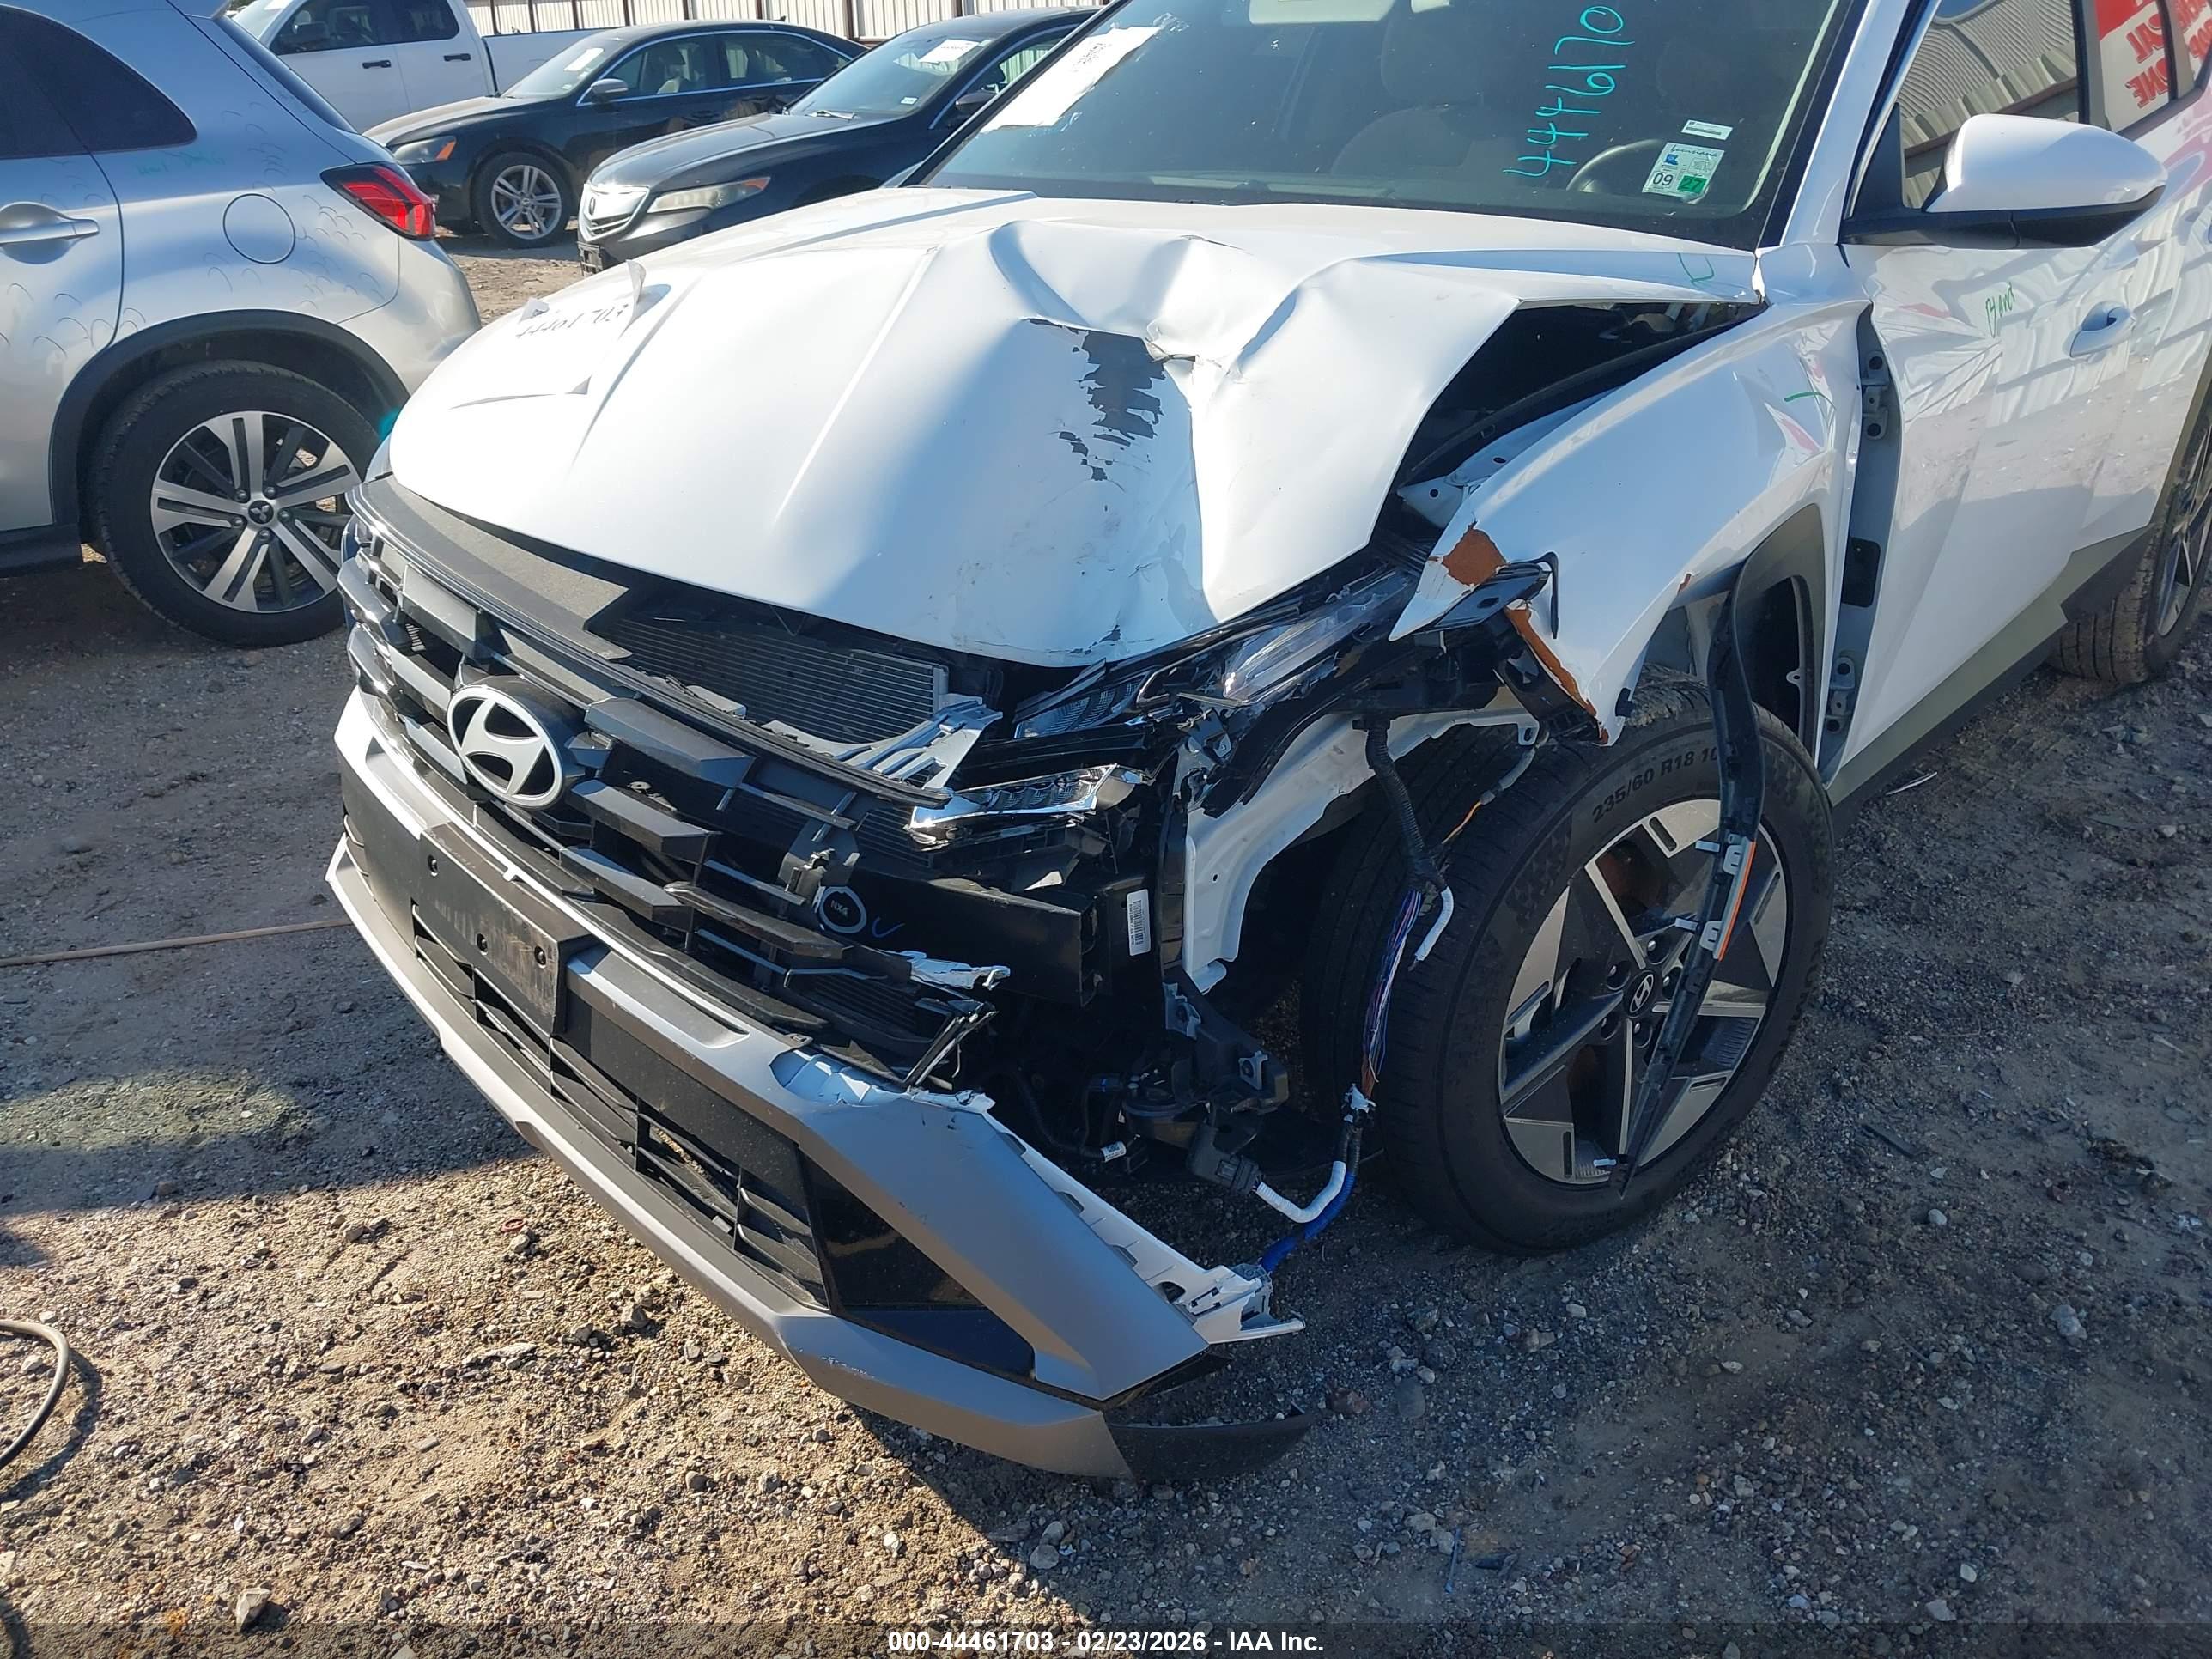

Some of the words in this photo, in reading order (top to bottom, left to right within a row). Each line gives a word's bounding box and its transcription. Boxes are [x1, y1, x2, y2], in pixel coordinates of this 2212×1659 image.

[1503, 5, 1636, 177] 4446170
[1652, 173, 1674, 186] 09
[1680, 177, 1703, 191] 27
[1592, 767, 1655, 823] 235/60
[1660, 750, 1695, 776] R18
